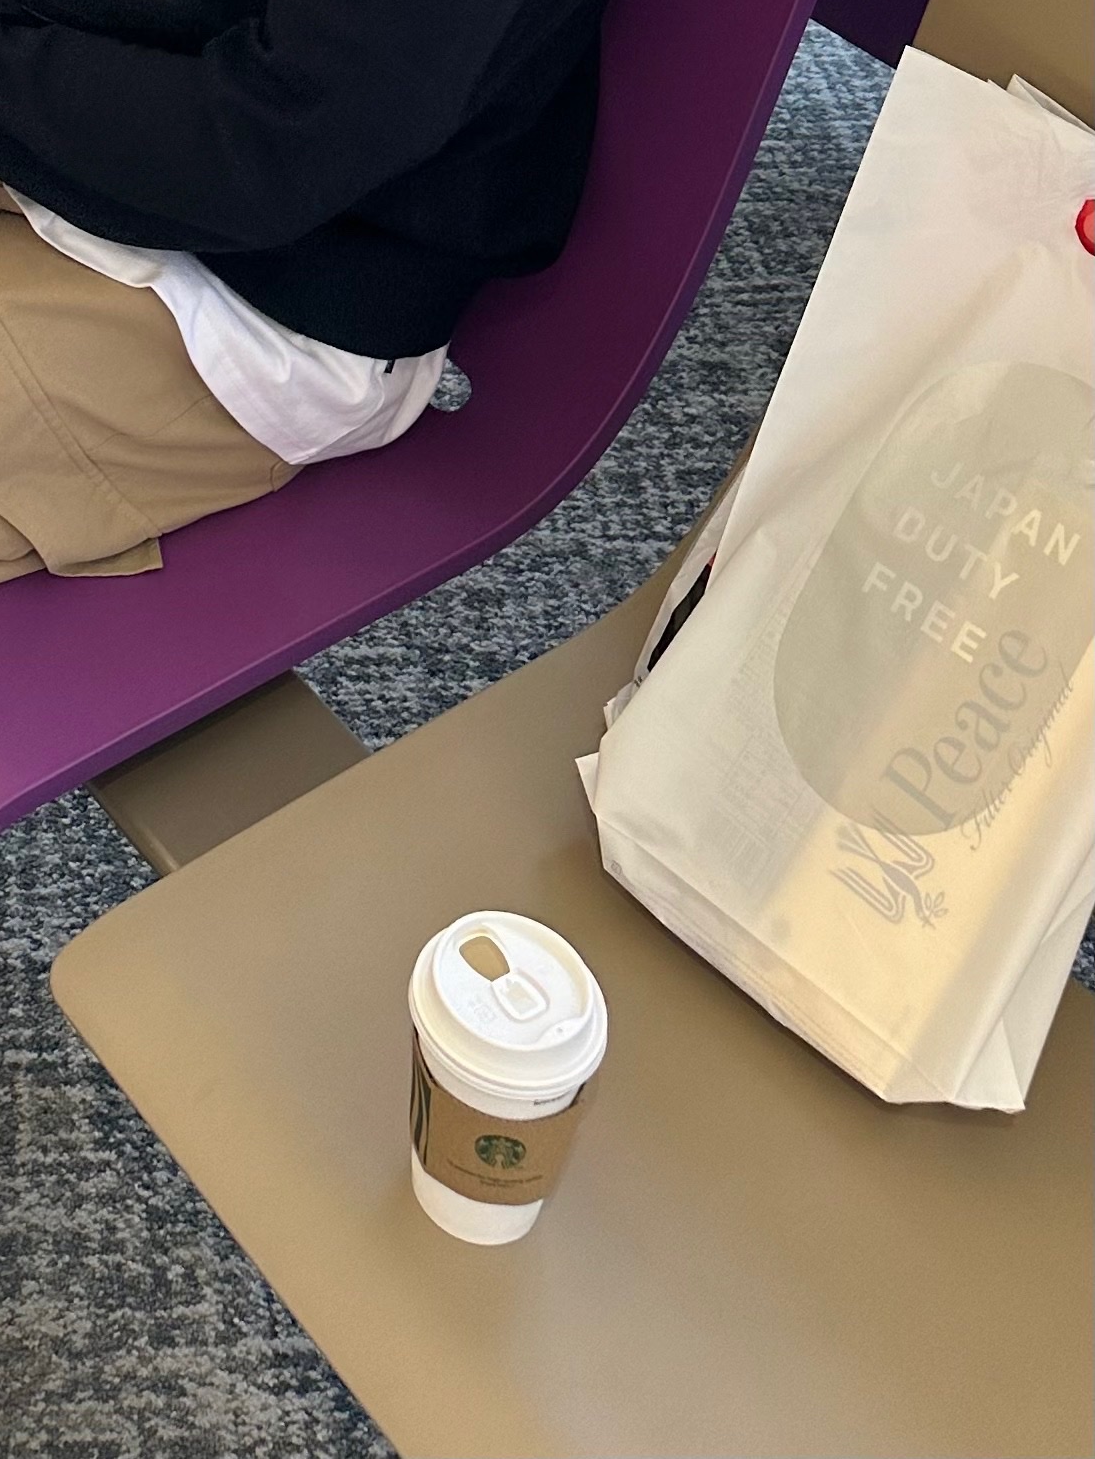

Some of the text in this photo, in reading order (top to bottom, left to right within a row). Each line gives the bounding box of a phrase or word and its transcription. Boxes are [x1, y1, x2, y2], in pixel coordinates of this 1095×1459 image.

[893, 506, 1019, 600] DUTY
[930, 462, 1081, 566] JAPAN
[861, 562, 987, 663] FREE
[879, 629, 1048, 832] Peace
